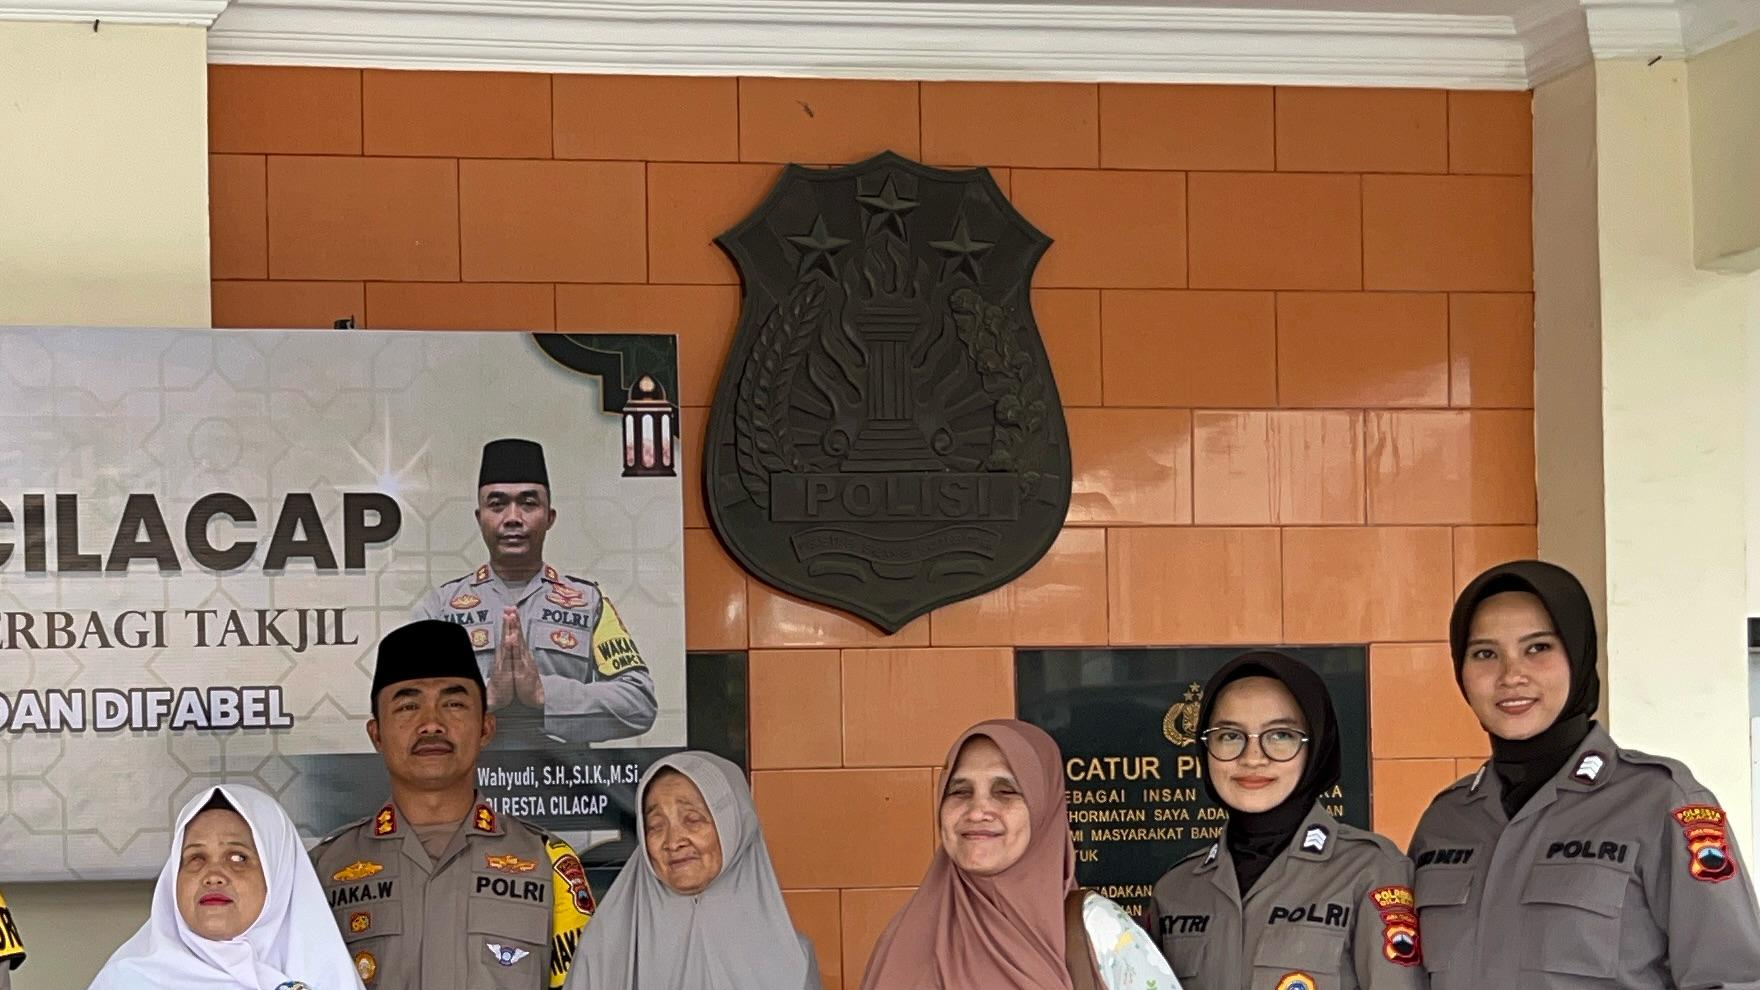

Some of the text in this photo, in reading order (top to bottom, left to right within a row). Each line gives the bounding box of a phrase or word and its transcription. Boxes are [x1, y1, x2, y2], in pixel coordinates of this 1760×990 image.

[806, 477, 992, 518] POLISI
[542, 608, 590, 628] POLRI
[185, 608, 359, 652] TAKJIL
[93, 686, 294, 733] DIFABEL
[477, 767, 539, 790] Wahyudi,
[1066, 757, 1160, 781] CATUR
[550, 795, 608, 816] CILACAP
[1065, 788, 1197, 804] EBAGAI INSAN
[1069, 808, 1230, 823] HORMATAN SAYA ADA
[1091, 827, 1184, 841] MASYARAKAT
[1546, 840, 1628, 864] POLRI
[476, 876, 545, 903] POLRI
[1098, 885, 1153, 898] ADAKAN
[1268, 902, 1350, 928] POLRI
